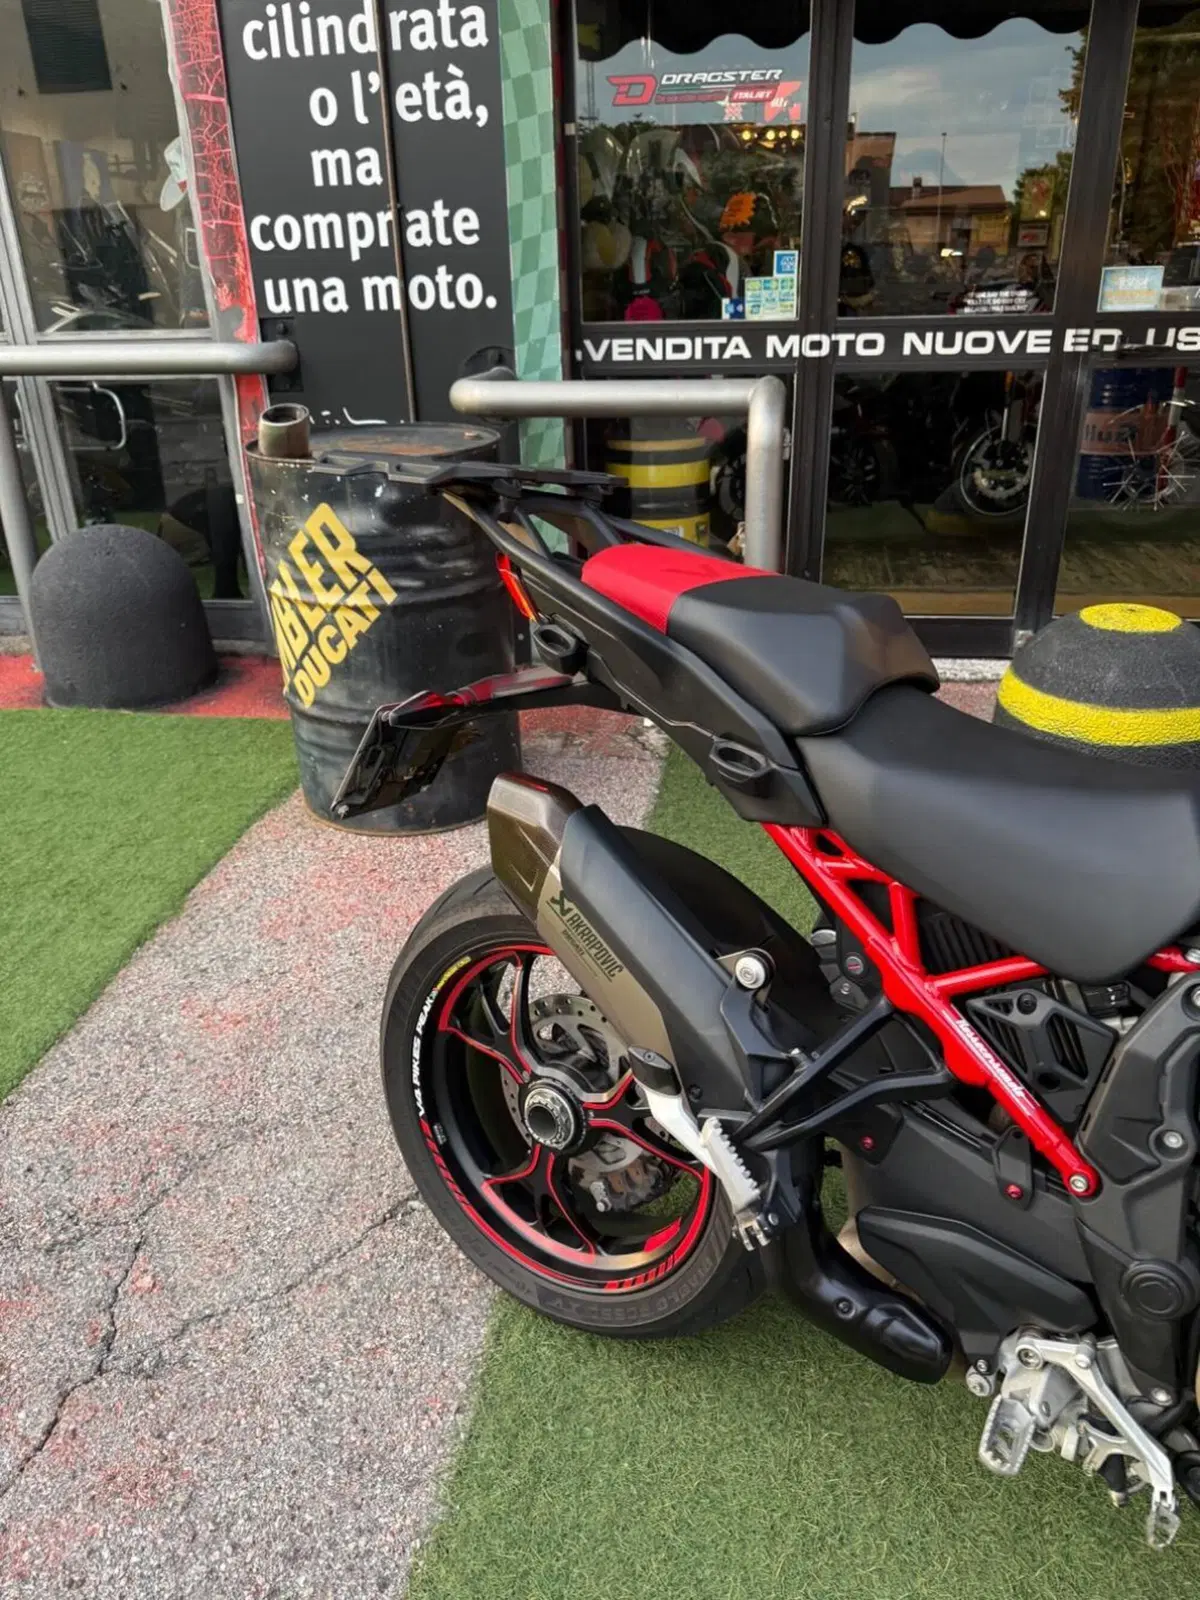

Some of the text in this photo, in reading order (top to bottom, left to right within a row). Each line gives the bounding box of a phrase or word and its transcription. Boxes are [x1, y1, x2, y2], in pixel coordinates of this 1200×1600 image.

[661, 69, 783, 85] DRAGSTER
[309, 87, 338, 127] o
[311, 147, 383, 187] ma
[250, 200, 480, 262] comprate
[264, 265, 497, 313] una moto.
[583, 336, 752, 362] VENDITA
[767, 332, 886, 358] MOTO
[903, 329, 1053, 356] NUOVE
[293, 567, 398, 708] DUCATI
[412, 1035, 422, 1087] PIKES
